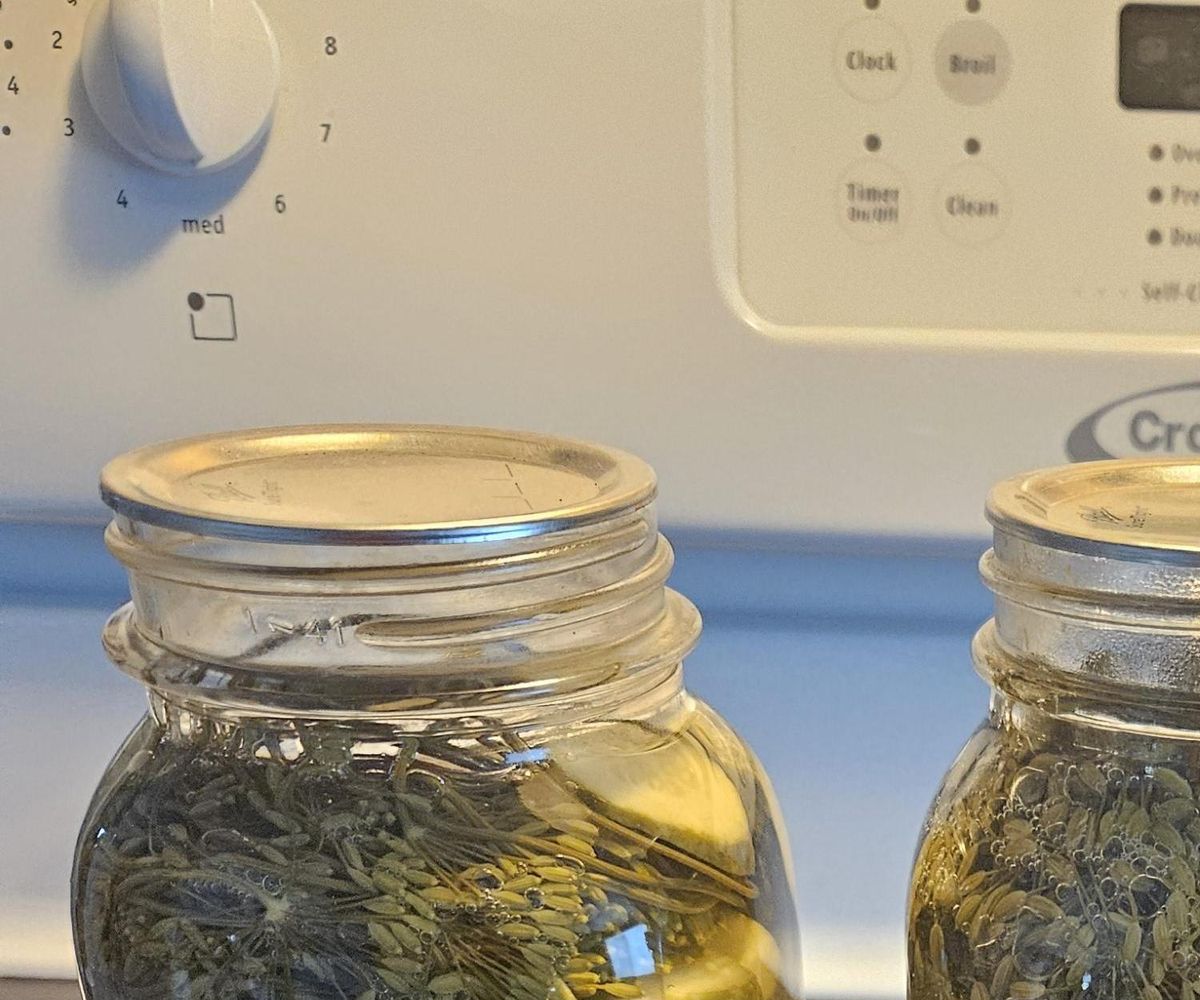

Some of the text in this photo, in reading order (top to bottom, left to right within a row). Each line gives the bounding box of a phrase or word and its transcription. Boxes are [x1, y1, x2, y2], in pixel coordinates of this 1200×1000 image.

[52, 30, 63, 49] 2
[325, 36, 338, 55] 8
[846, 50, 897, 72] Clock
[949, 54, 997, 75] Broil
[7, 75, 19, 95] 4
[64, 118, 75, 136] 3
[320, 123, 331, 142] 7
[116, 190, 128, 208] 4
[275, 195, 286, 213] 6
[946, 196, 998, 216] Clean
[182, 215, 225, 235] med
